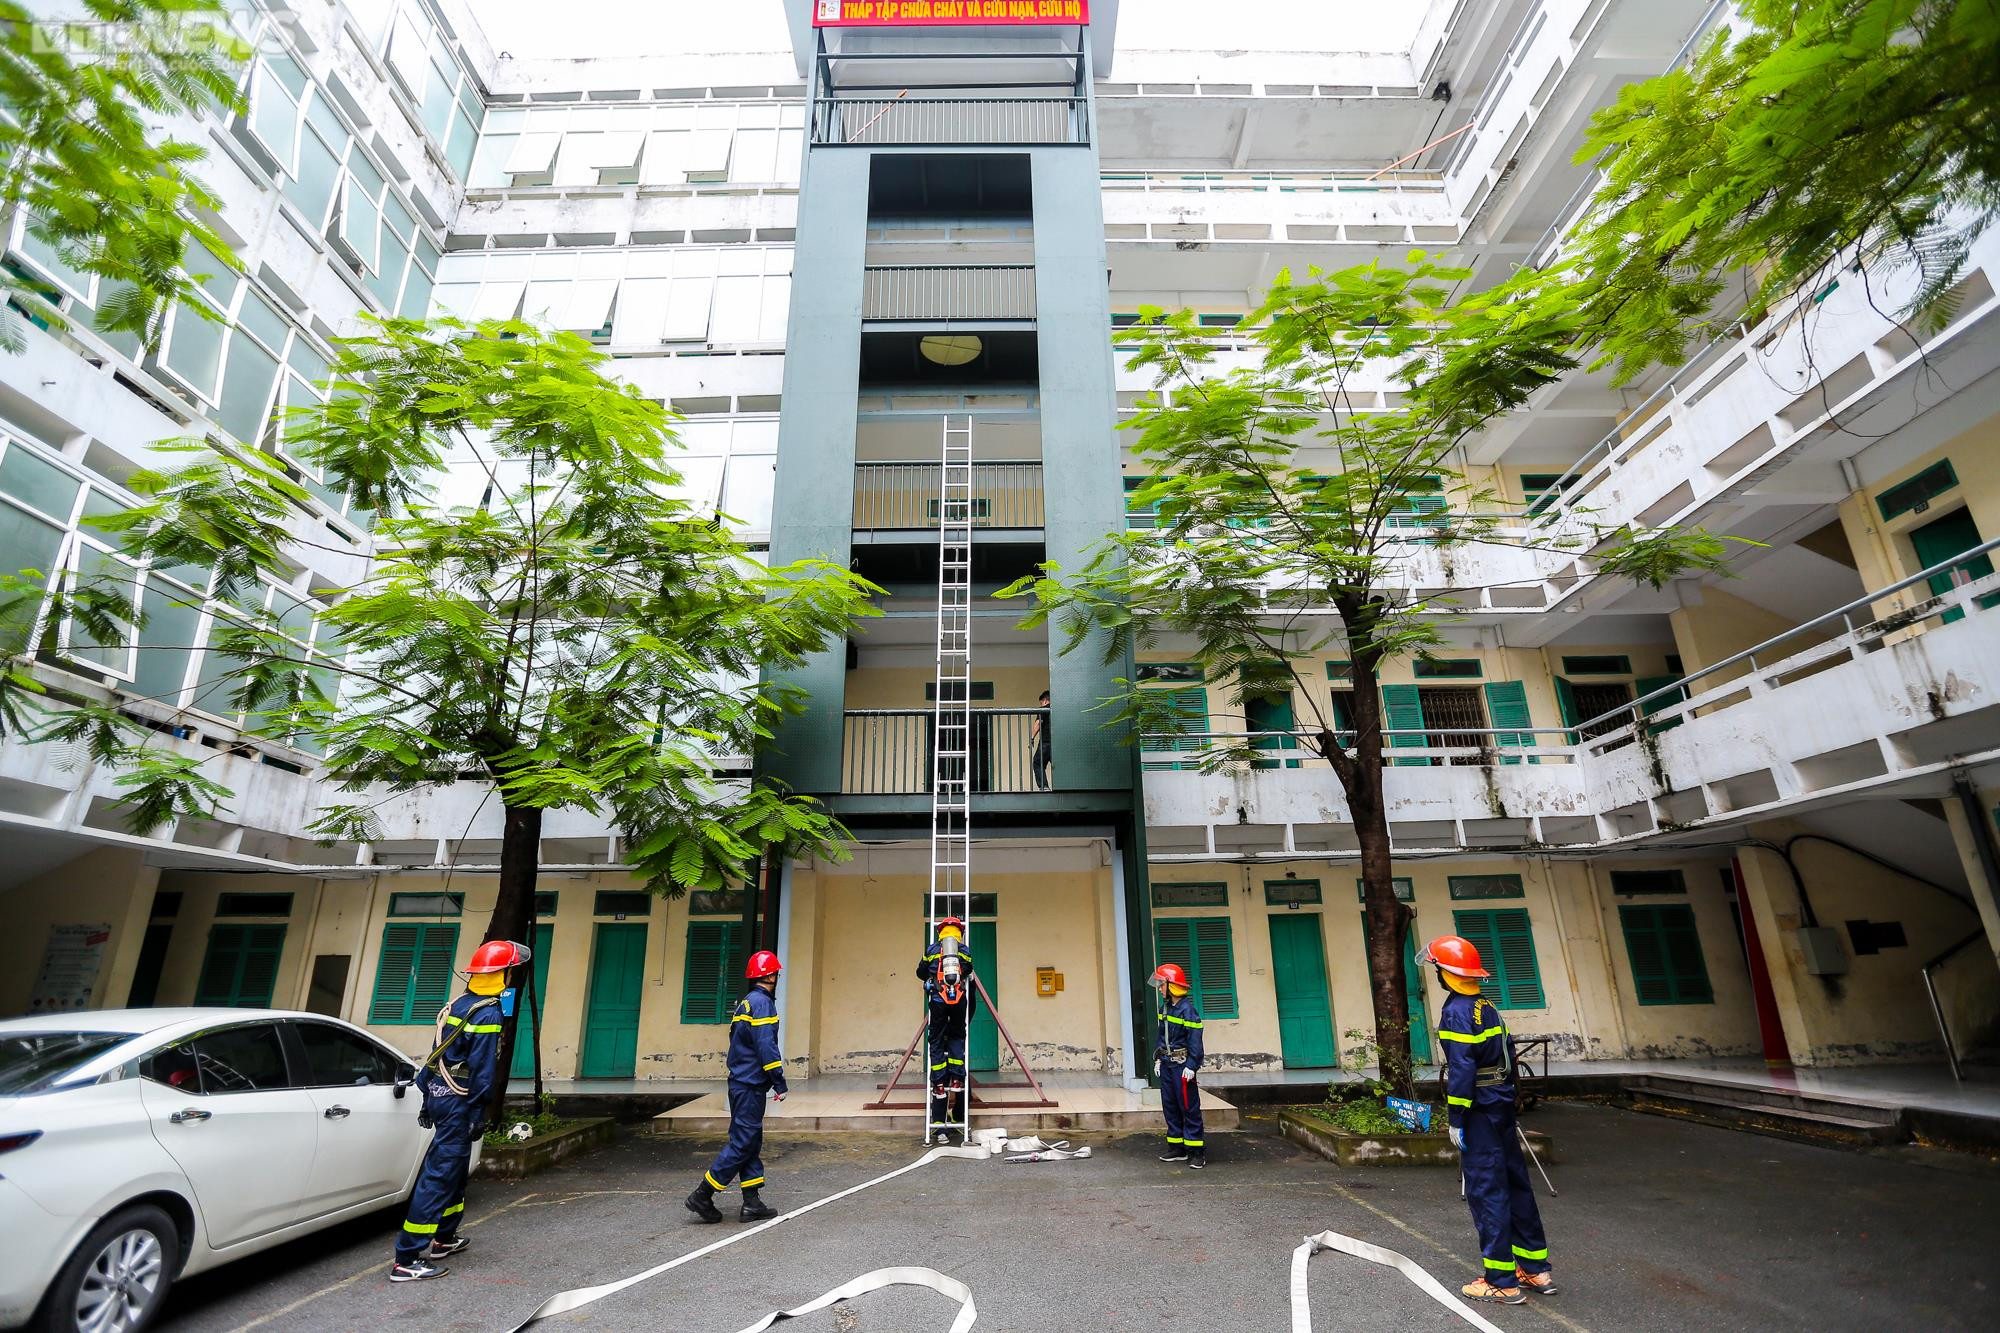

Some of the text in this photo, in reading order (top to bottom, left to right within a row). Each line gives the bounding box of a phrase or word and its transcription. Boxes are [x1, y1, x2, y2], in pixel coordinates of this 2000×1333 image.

[844, 1, 873, 18] THÁP
[876, 0, 898, 21] TẬP
[933, 0, 964, 18] CHÁY
